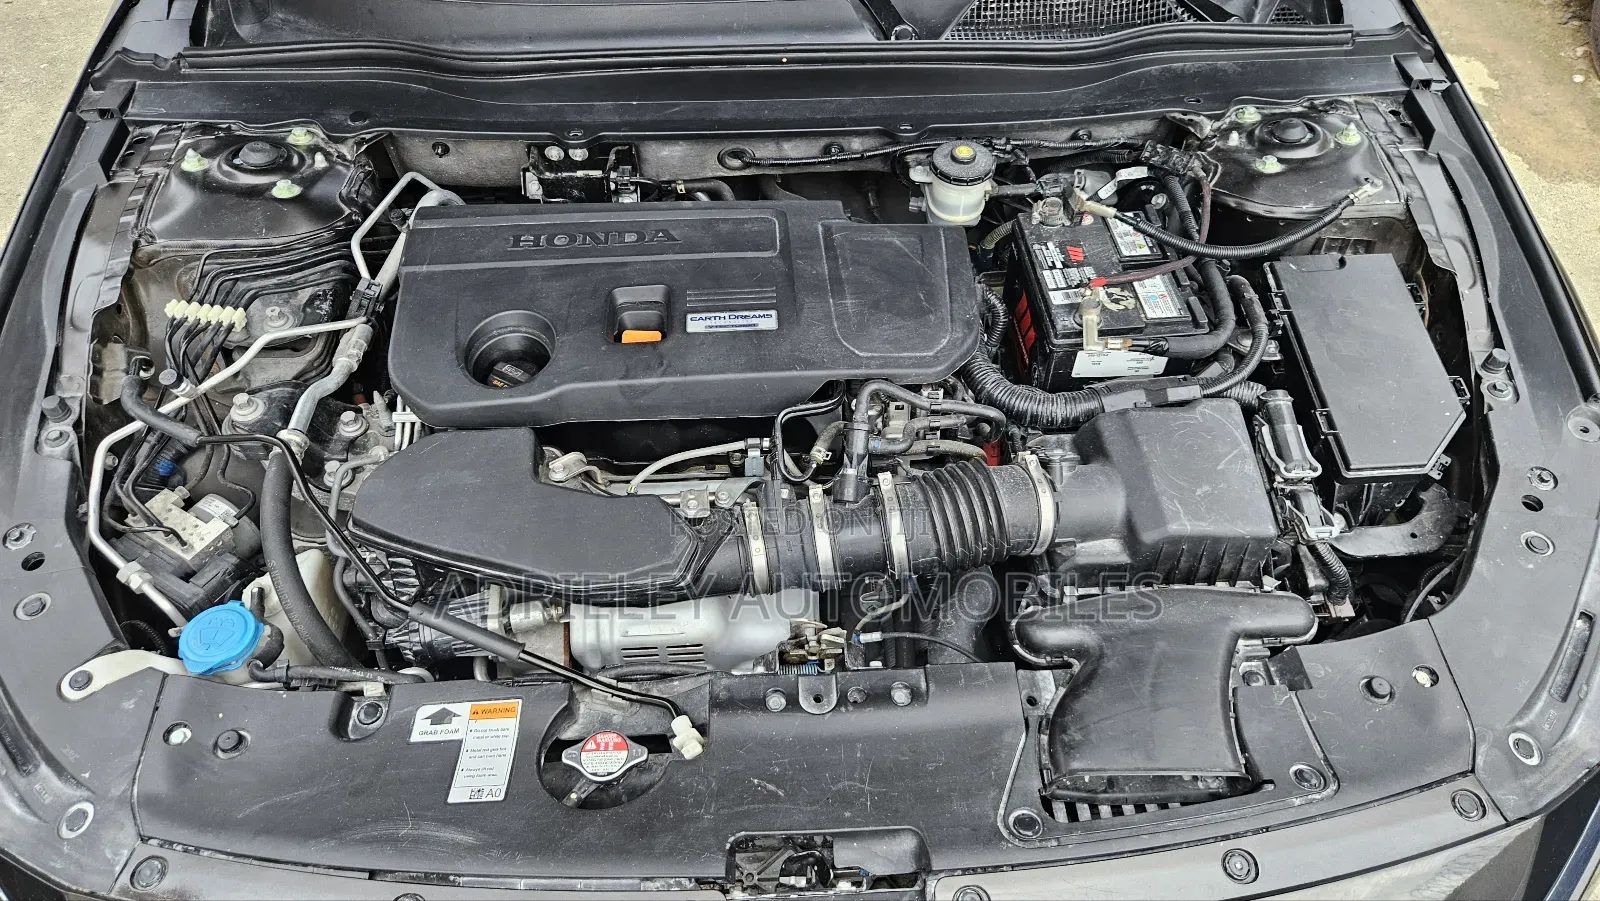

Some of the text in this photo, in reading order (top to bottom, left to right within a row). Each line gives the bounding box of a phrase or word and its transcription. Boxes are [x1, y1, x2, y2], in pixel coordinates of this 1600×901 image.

[507, 229, 682, 250] HONDA
[481, 706, 516, 715] WARNING
[632, 748, 642, 757] 1.1
